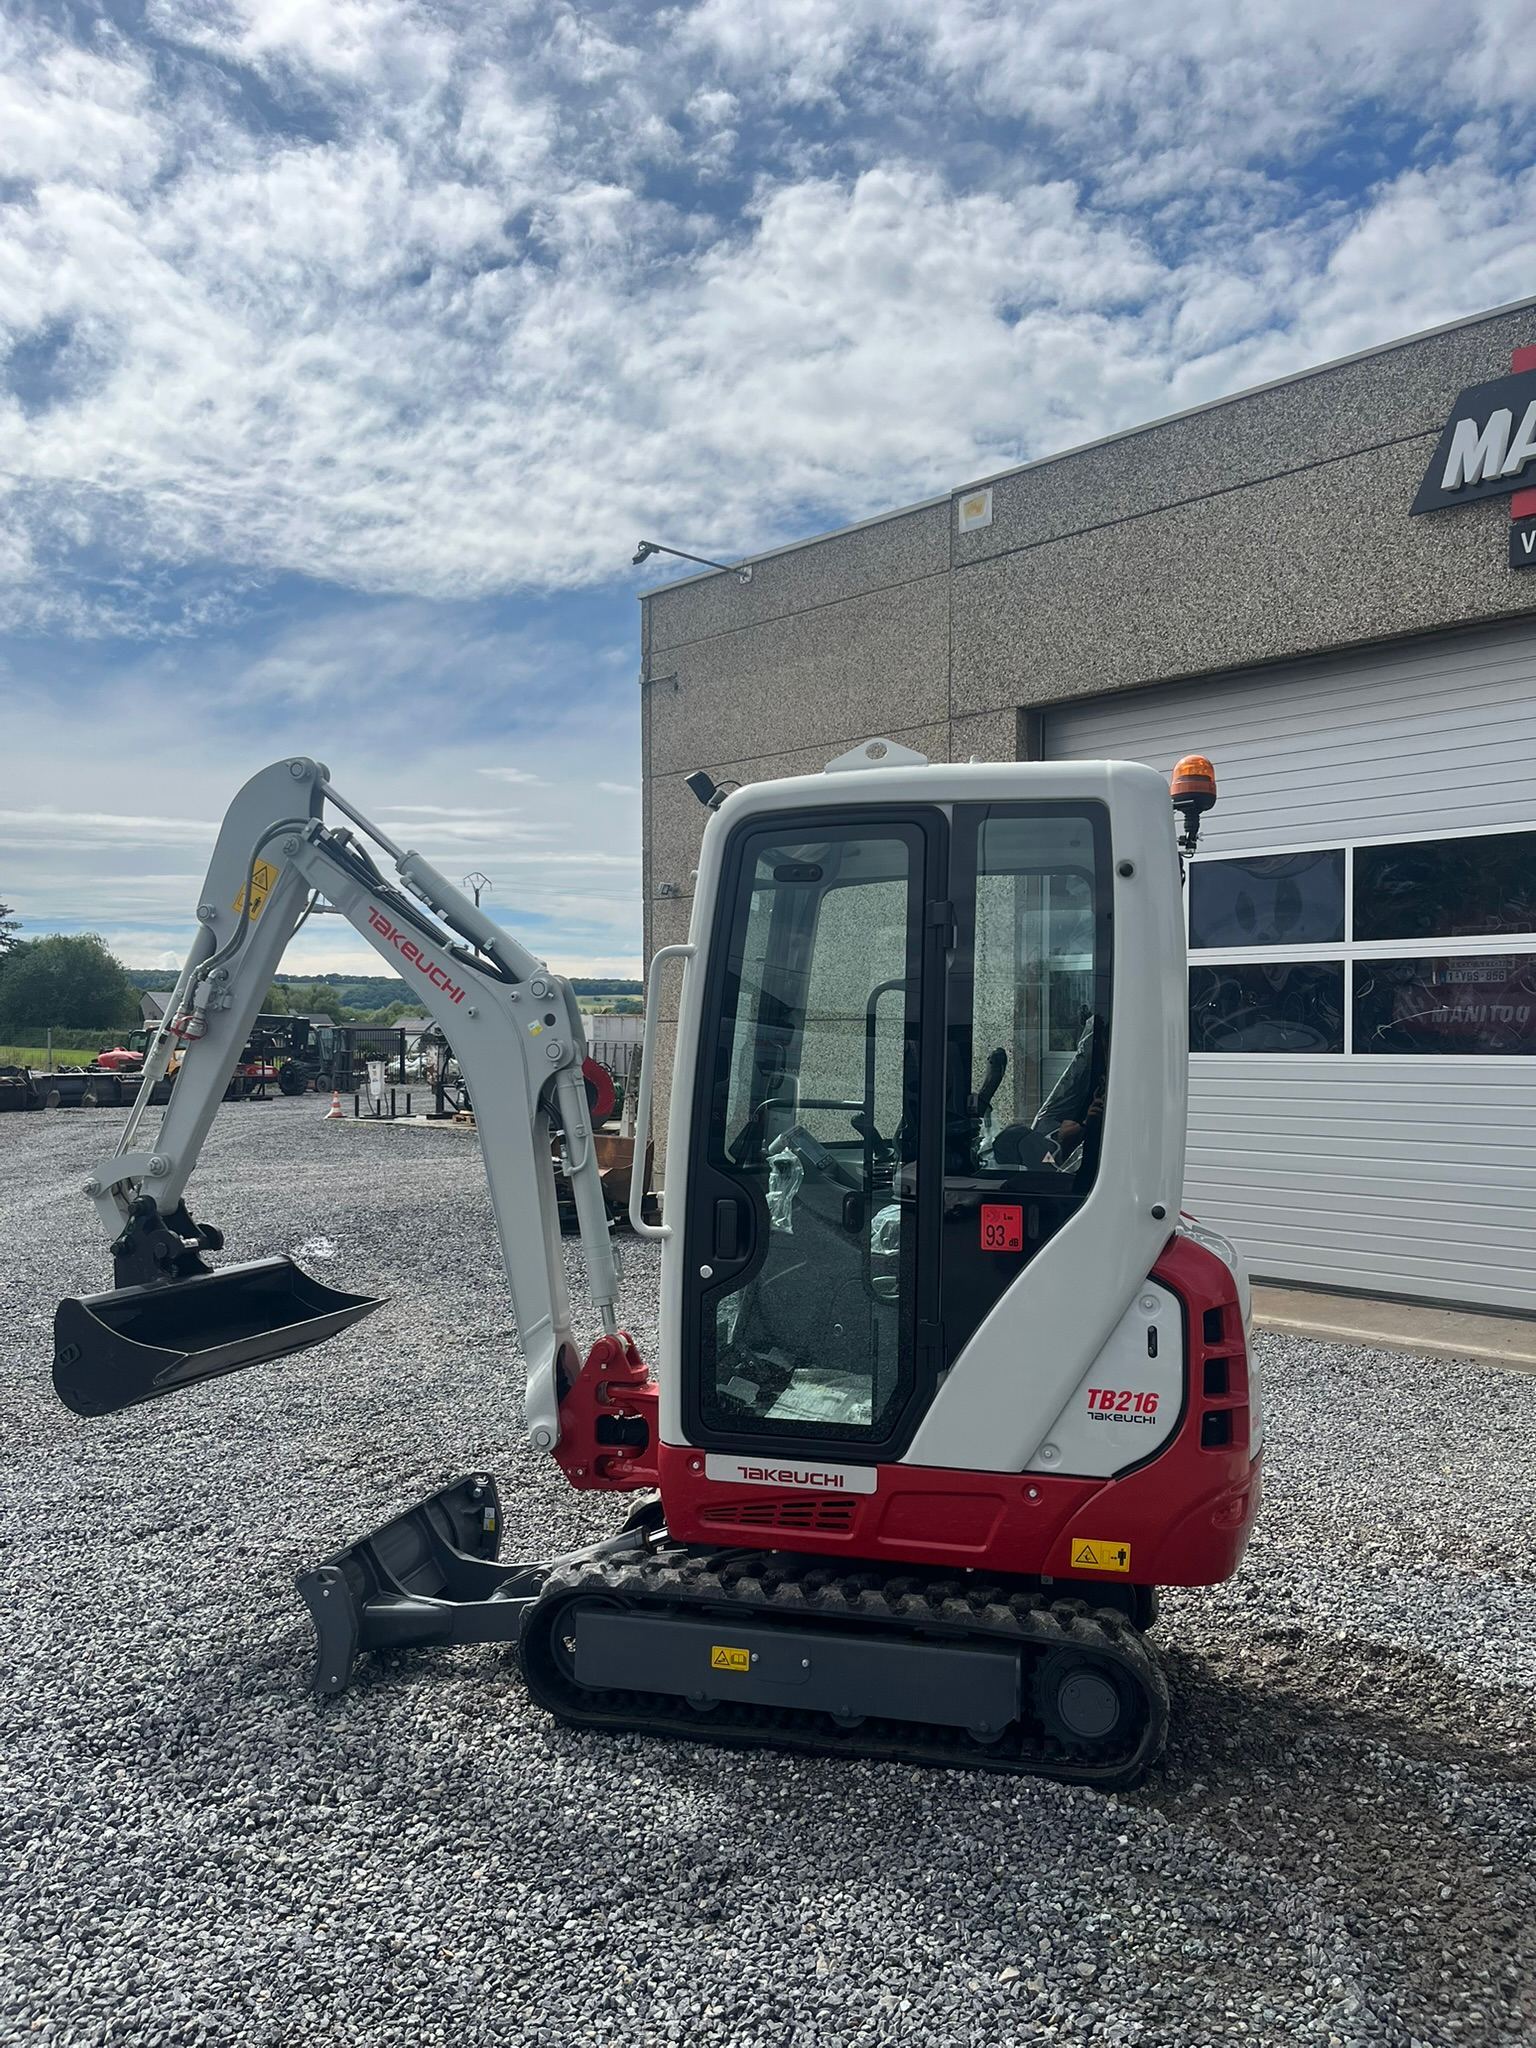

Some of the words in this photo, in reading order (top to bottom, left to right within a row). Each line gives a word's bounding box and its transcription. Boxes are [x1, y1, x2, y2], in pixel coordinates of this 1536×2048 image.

[367, 905, 466, 1005] TAKEUCHI
[1431, 1004, 1531, 1023] MANITOU
[986, 1224, 1005, 1246] 93
[1008, 1238, 1019, 1247] dB
[1087, 1388, 1160, 1414] TB216
[1087, 1411, 1156, 1425] TAKEUCHI
[737, 1466, 844, 1488] TAKEUCHI
